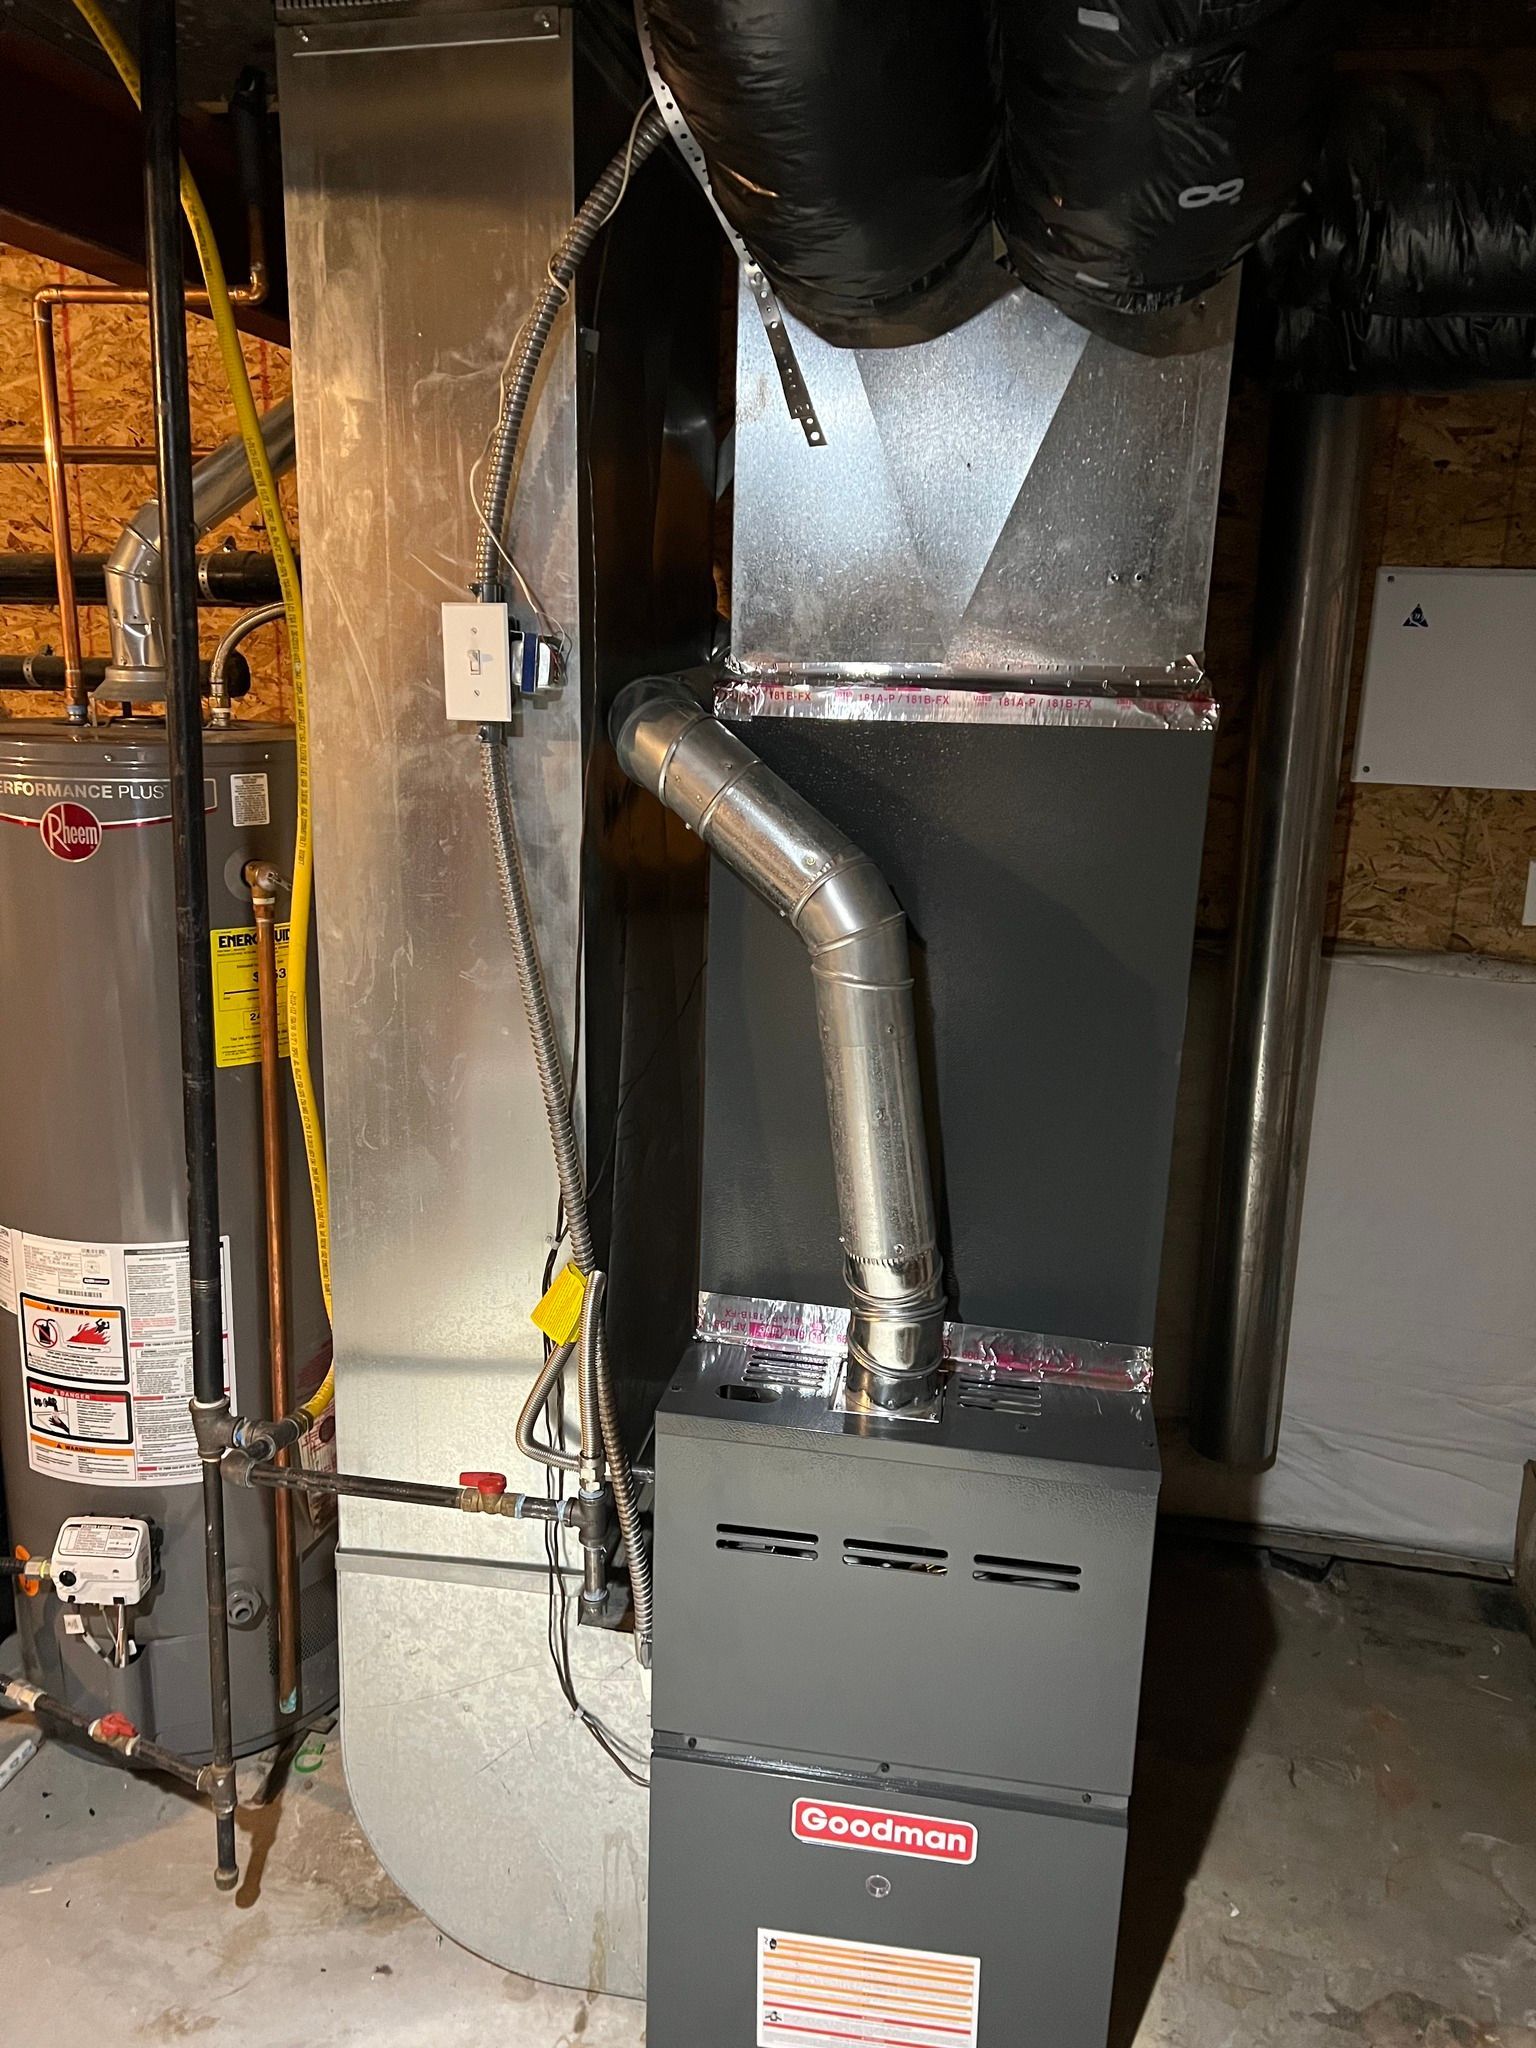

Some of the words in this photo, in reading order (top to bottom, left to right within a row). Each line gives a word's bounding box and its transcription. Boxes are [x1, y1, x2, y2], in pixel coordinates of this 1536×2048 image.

[905, 694, 950, 705] 181B-FX
[999, 697, 1036, 707] 181A-P
[1047, 698, 1093, 710] 181B-FX
[118, 785, 165, 800] PLUS
[47, 804, 99, 852] Rheem
[60, 1391, 91, 1400] DANGER
[65, 1443, 96, 1454] WARNING
[801, 1807, 967, 1853] Goodman
